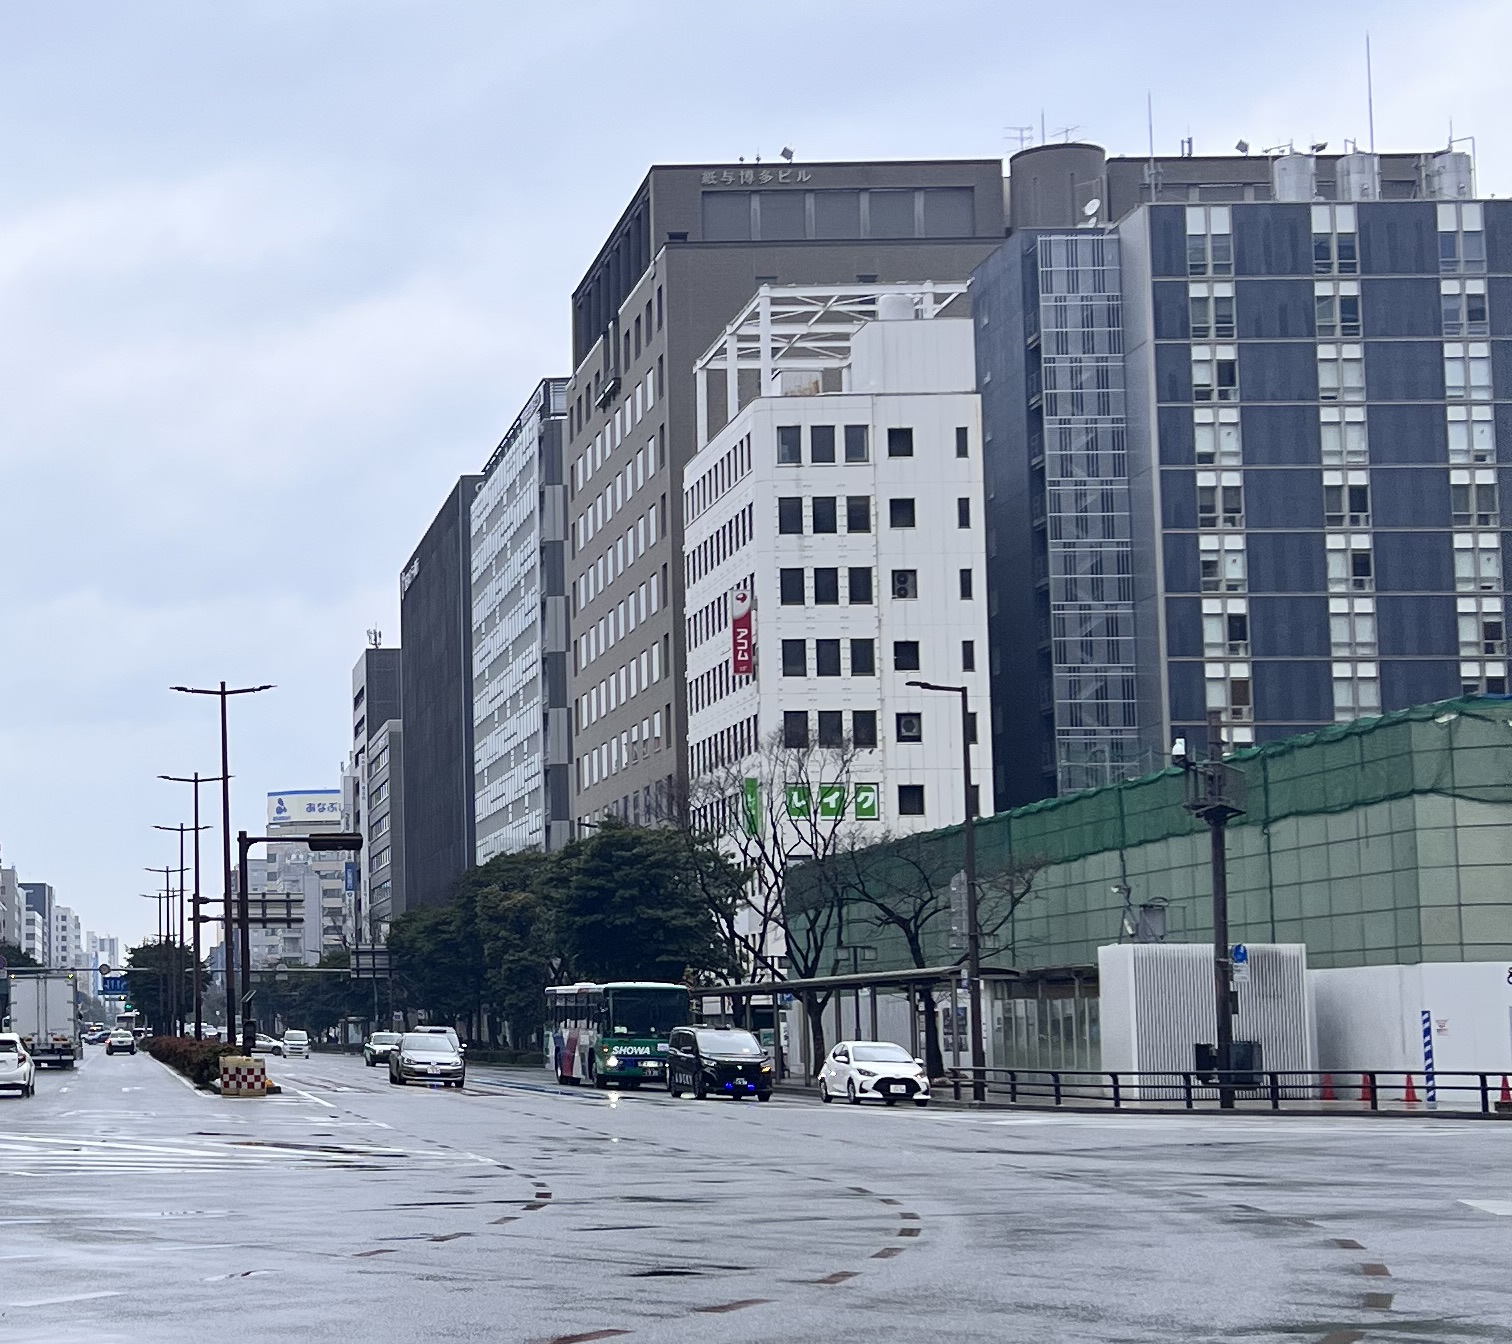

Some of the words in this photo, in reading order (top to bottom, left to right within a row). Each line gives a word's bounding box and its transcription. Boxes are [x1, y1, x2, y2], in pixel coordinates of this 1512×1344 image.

[701, 169, 812, 185] 紙与博多ビル
[792, 792, 875, 808] レイク
[611, 1045, 651, 1055] SHOWA
